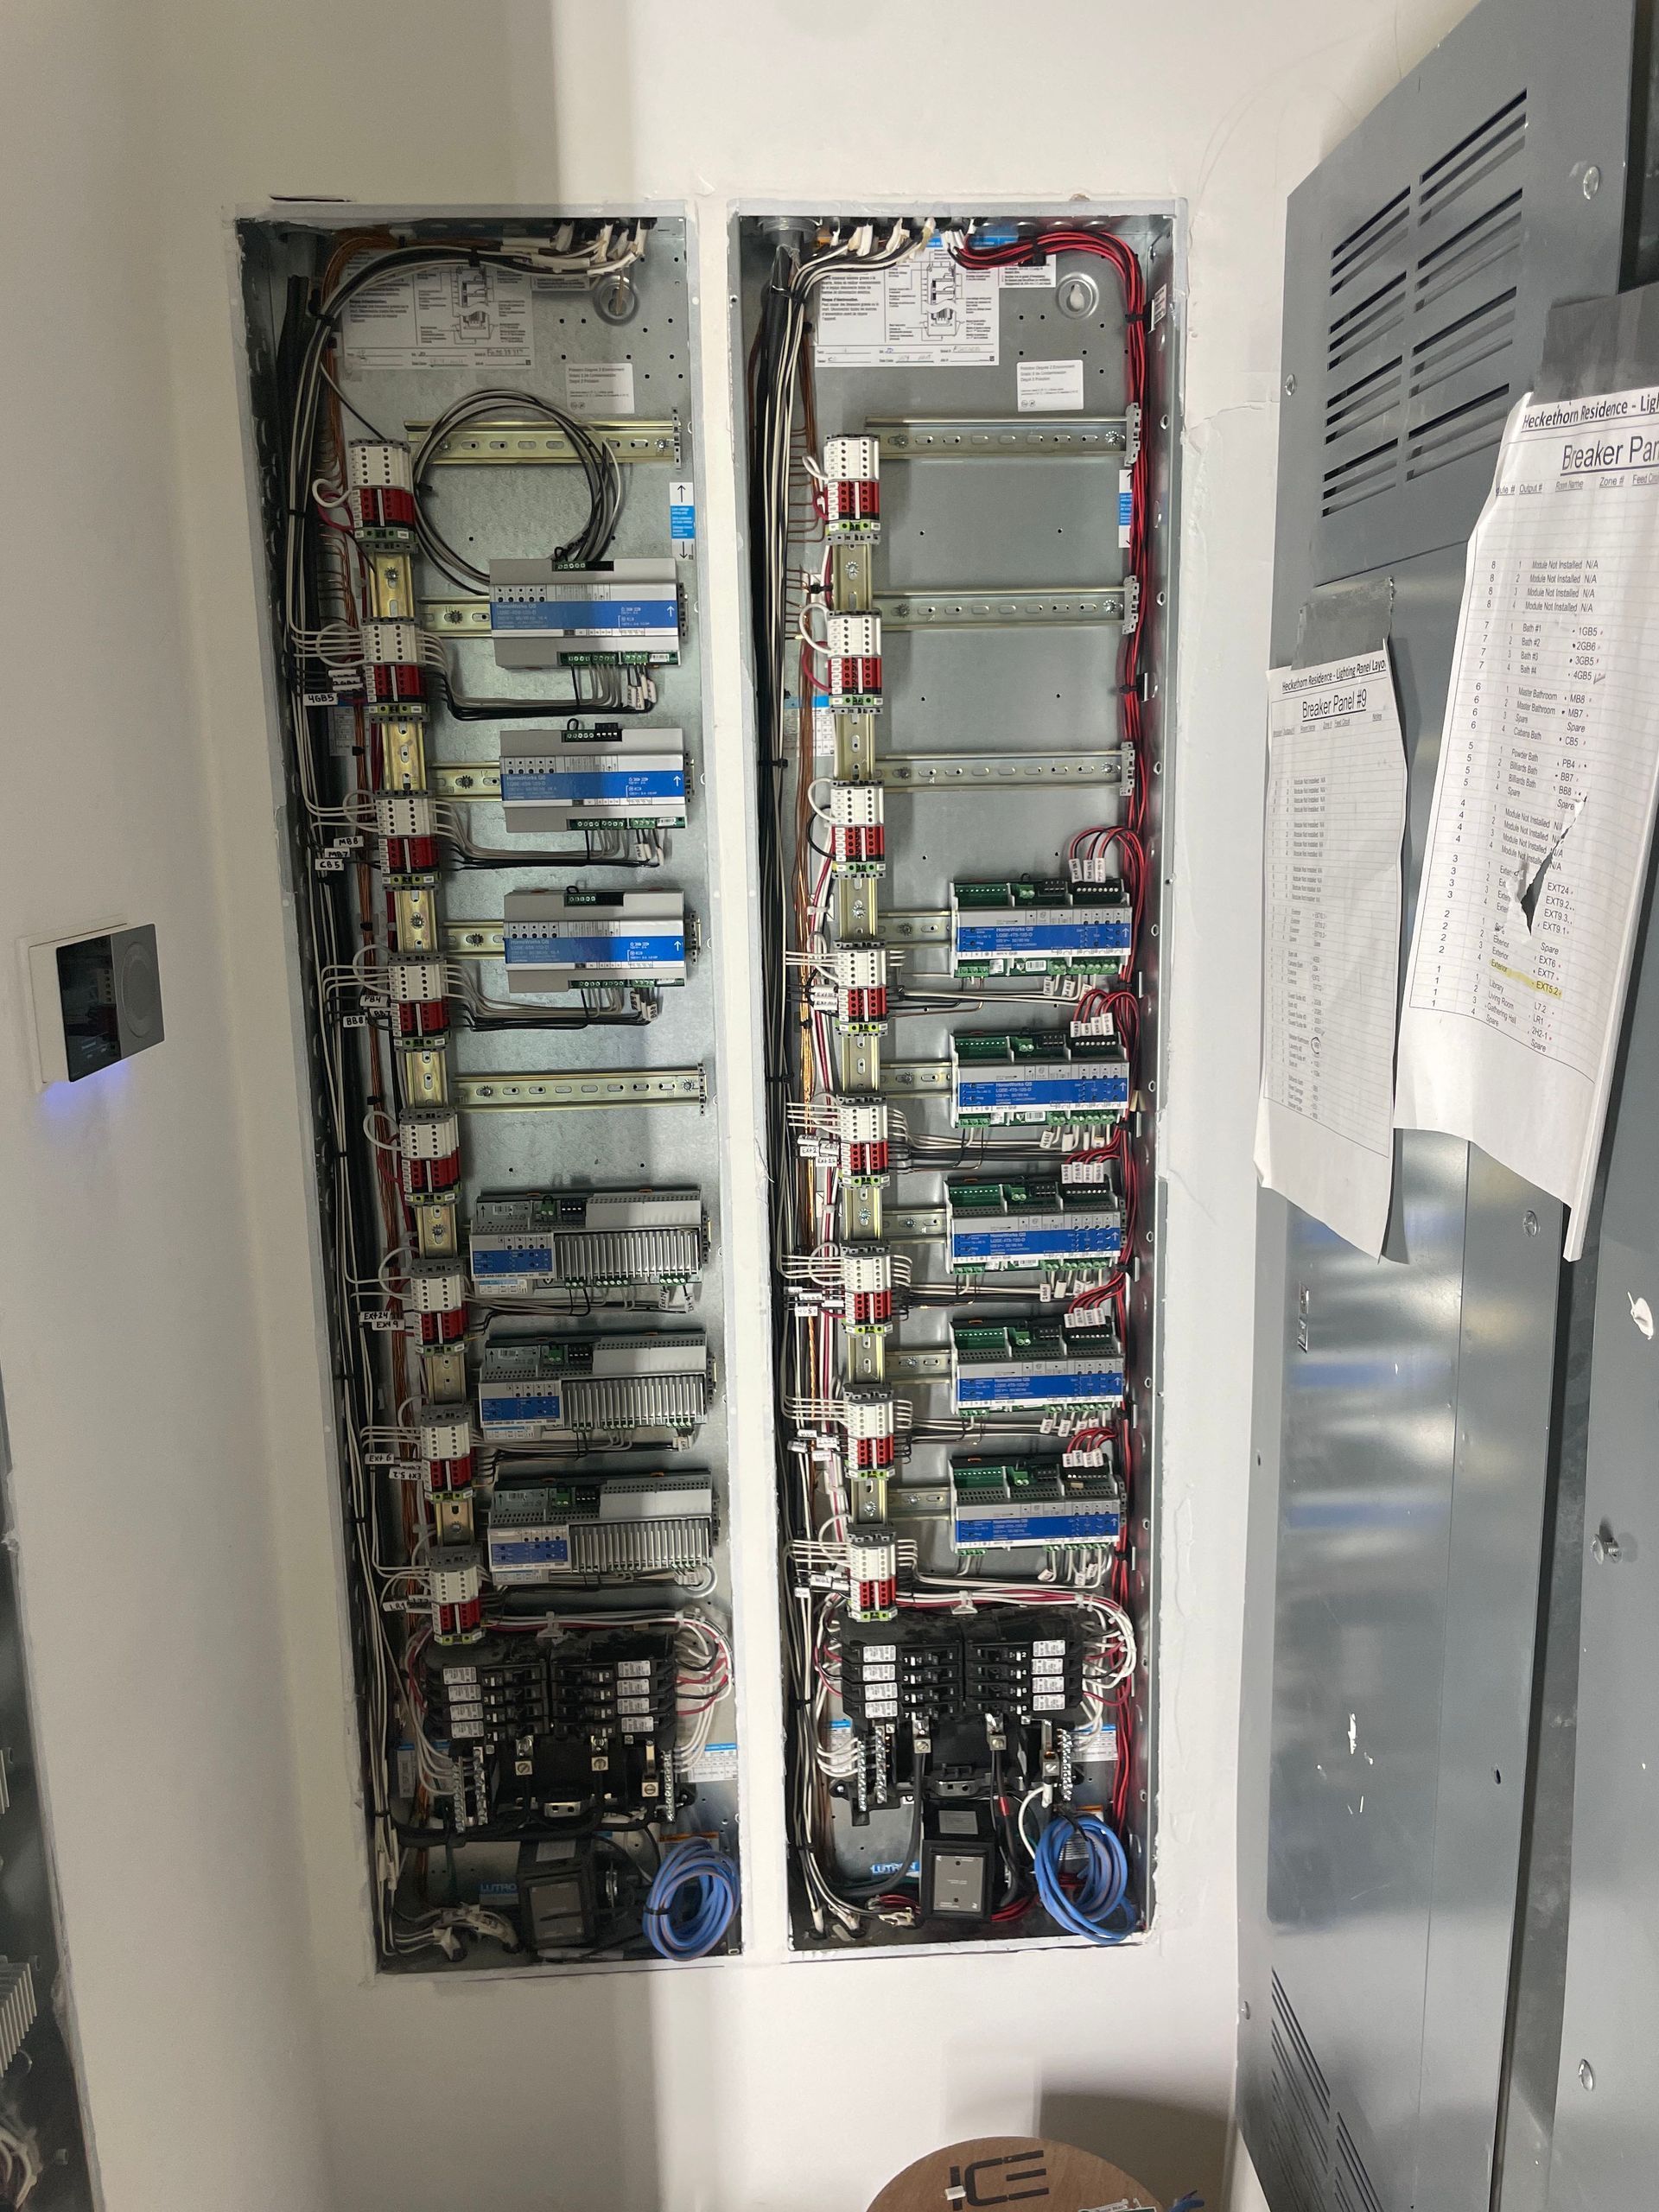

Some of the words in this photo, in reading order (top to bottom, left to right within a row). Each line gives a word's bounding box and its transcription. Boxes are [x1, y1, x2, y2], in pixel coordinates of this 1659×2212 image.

[1522, 409, 1579, 429] Heckethorn
[1580, 401, 1628, 420] Residence
[1562, 441, 1623, 470] Breaker
[1600, 476, 1617, 486] Zone
[1586, 560, 1599, 569] N/A
[1585, 575, 1597, 583] N/A
[1528, 588, 1544, 597] Module
[1556, 589, 1579, 598] Installed
[1583, 589, 1595, 598] N/A
[1525, 601, 1542, 610] Module
[1554, 602, 1578, 612] Installed
[1581, 603, 1592, 612] N/A
[1580, 626, 1597, 636] 1GB5
[1577, 641, 1596, 651] 2GB6
[1575, 656, 1593, 665] 3GB5
[1282, 677, 1307, 691] Heckethorn
[1309, 671, 1332, 684] Residence
[1357, 660, 1371, 675] Panel
[1573, 671, 1592, 680] 4GB5
[308, 694, 334, 702] 4GB5
[1302, 698, 1331, 718] Breaker
[1333, 691, 1355, 712] Panel
[1357, 689, 1367, 709] #9
[1570, 694, 1585, 703] MB8
[1568, 709, 1583, 718] MB7
[1567, 722, 1586, 733] Spare
[1566, 736, 1578, 746] CB5
[1562, 759, 1575, 768] PB4
[1560, 772, 1573, 782] BB7
[1559, 785, 1572, 795] BB8
[1557, 799, 1574, 810] Spare
[1505, 808, 1521, 819] Module
[1504, 821, 1519, 832] Module
[1503, 833, 1518, 845] Module
[1502, 845, 1516, 857] Module
[1527, 852, 1543, 864] Installe
[1548, 882, 1569, 895] EXT24
[1541, 942, 1559, 955] Spare
[1539, 956, 1556, 968] EXT6
[1537, 968, 1554, 980] EXT7
[1490, 979, 1504, 993] Library
[1533, 1014, 1544, 1025] LR1
[1486, 1014, 1499, 1027] Spare
[1531, 1039, 1547, 1052] Spare
[480, 1883, 518, 1892] LUTRO
